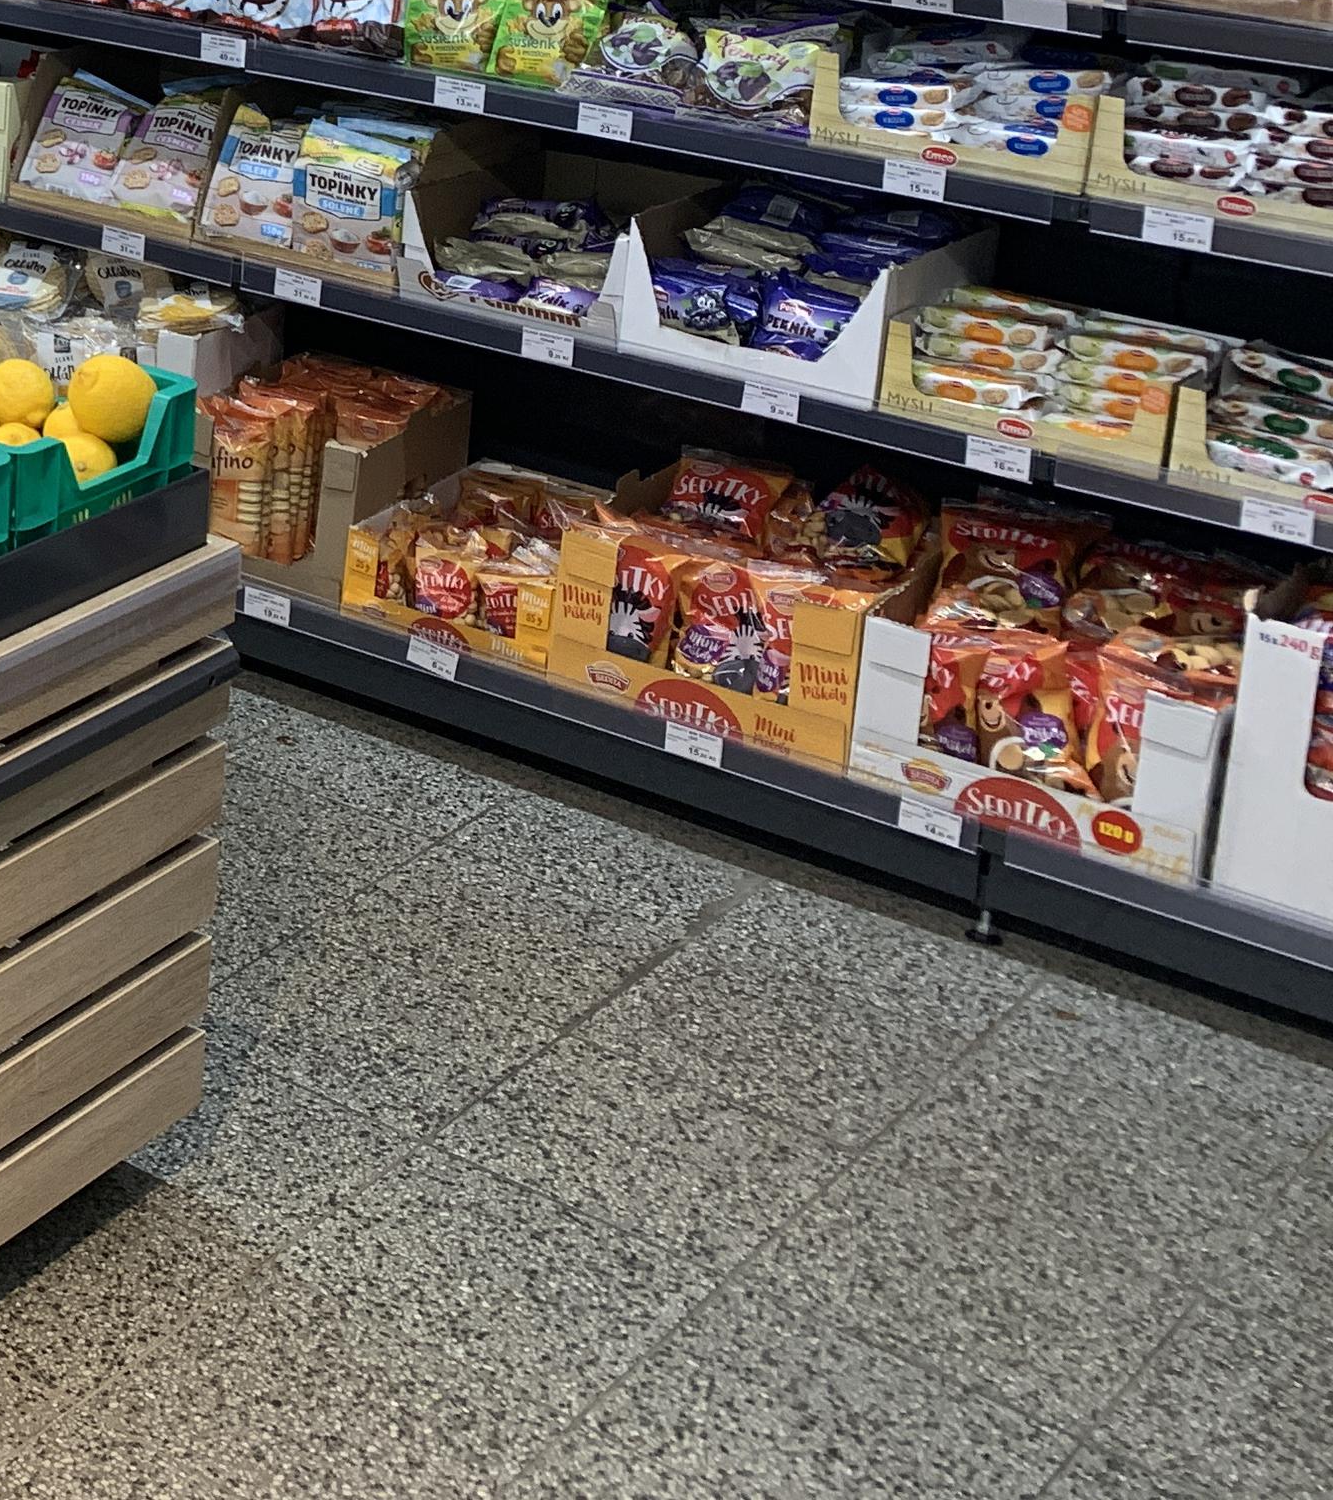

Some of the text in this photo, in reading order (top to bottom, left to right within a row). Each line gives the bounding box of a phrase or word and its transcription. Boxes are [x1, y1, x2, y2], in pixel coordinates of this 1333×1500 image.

[60, 96, 121, 123] TOPINKY
[308, 172, 379, 202] TOPINKY
[562, 581, 605, 607] Mini
[797, 659, 848, 687] Mini
